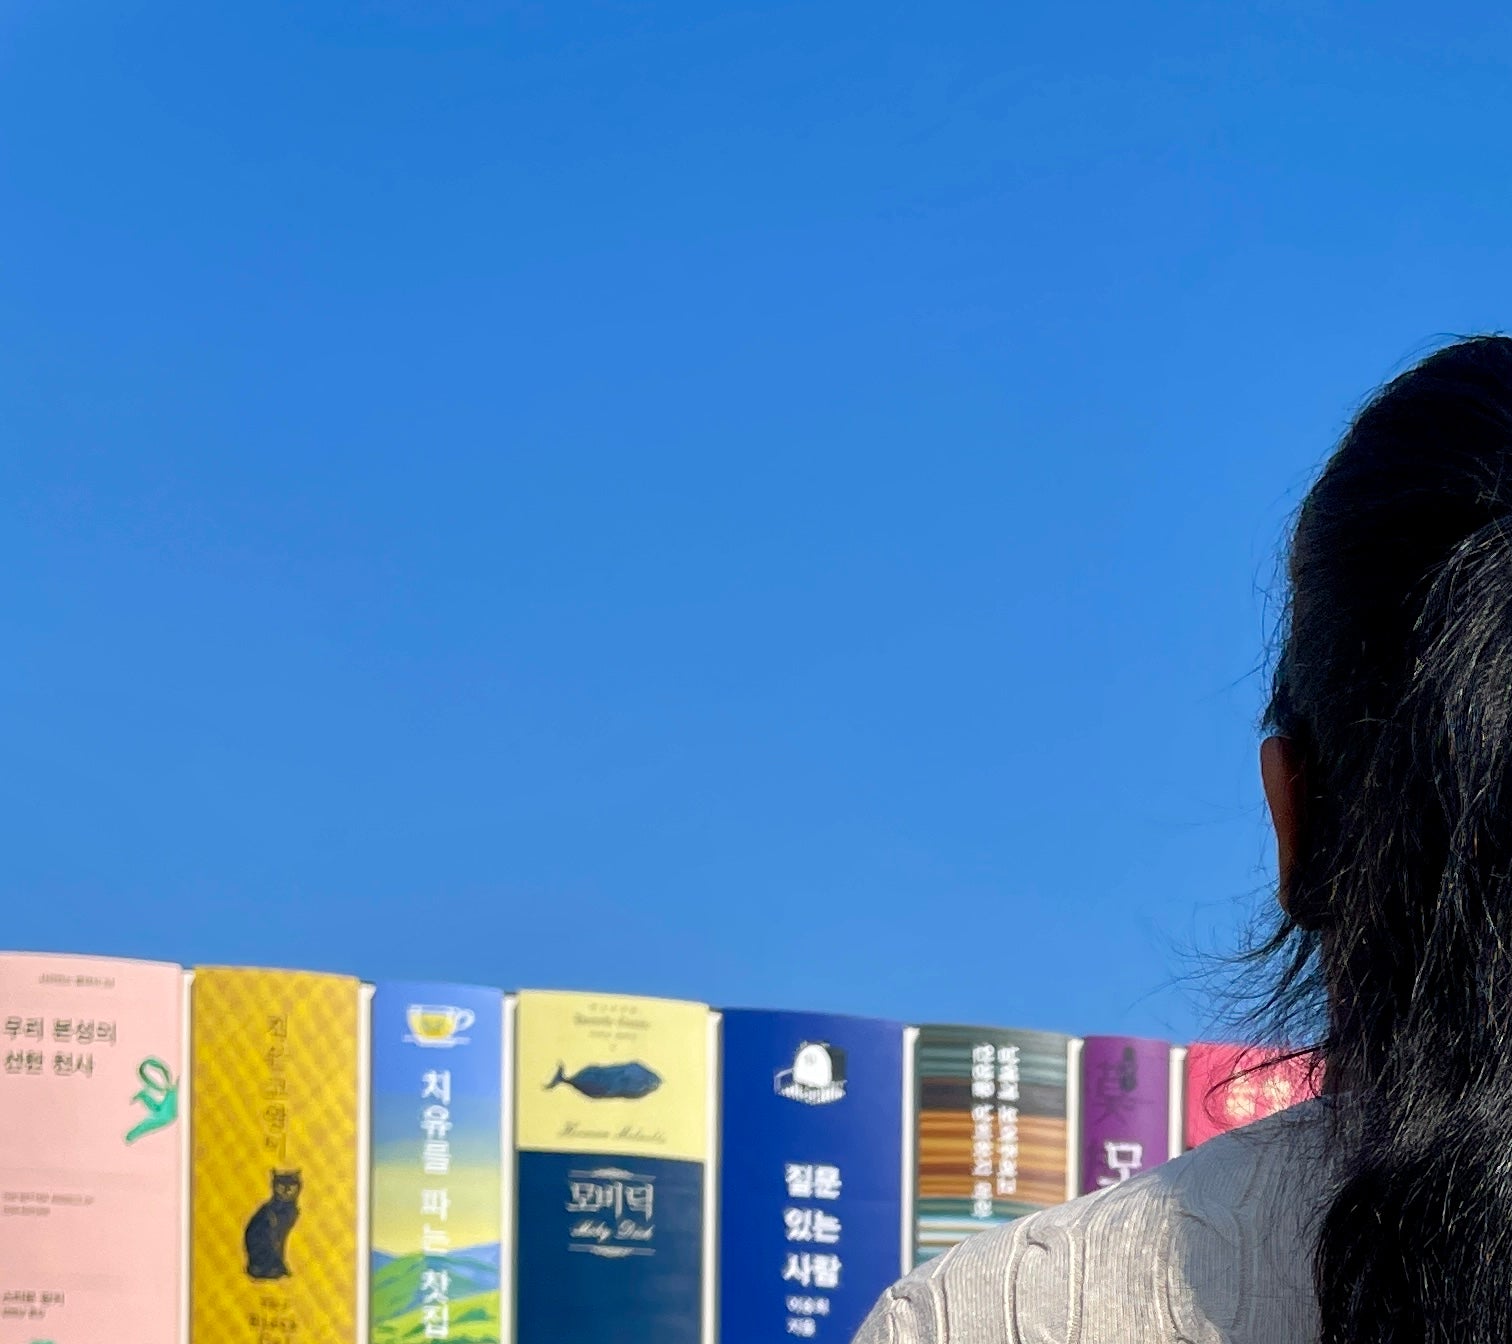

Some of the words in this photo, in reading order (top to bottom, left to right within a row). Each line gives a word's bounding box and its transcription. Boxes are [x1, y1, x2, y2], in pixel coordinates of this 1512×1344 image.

[420, 1070, 453, 1175] 치유를
[420, 1187, 449, 1256] 파는
[565, 1181, 654, 1222] 모비딕
[783, 1207, 842, 1244] 있는
[782, 1251, 842, 1289] 사람
[420, 1269, 450, 1340] 찻집
